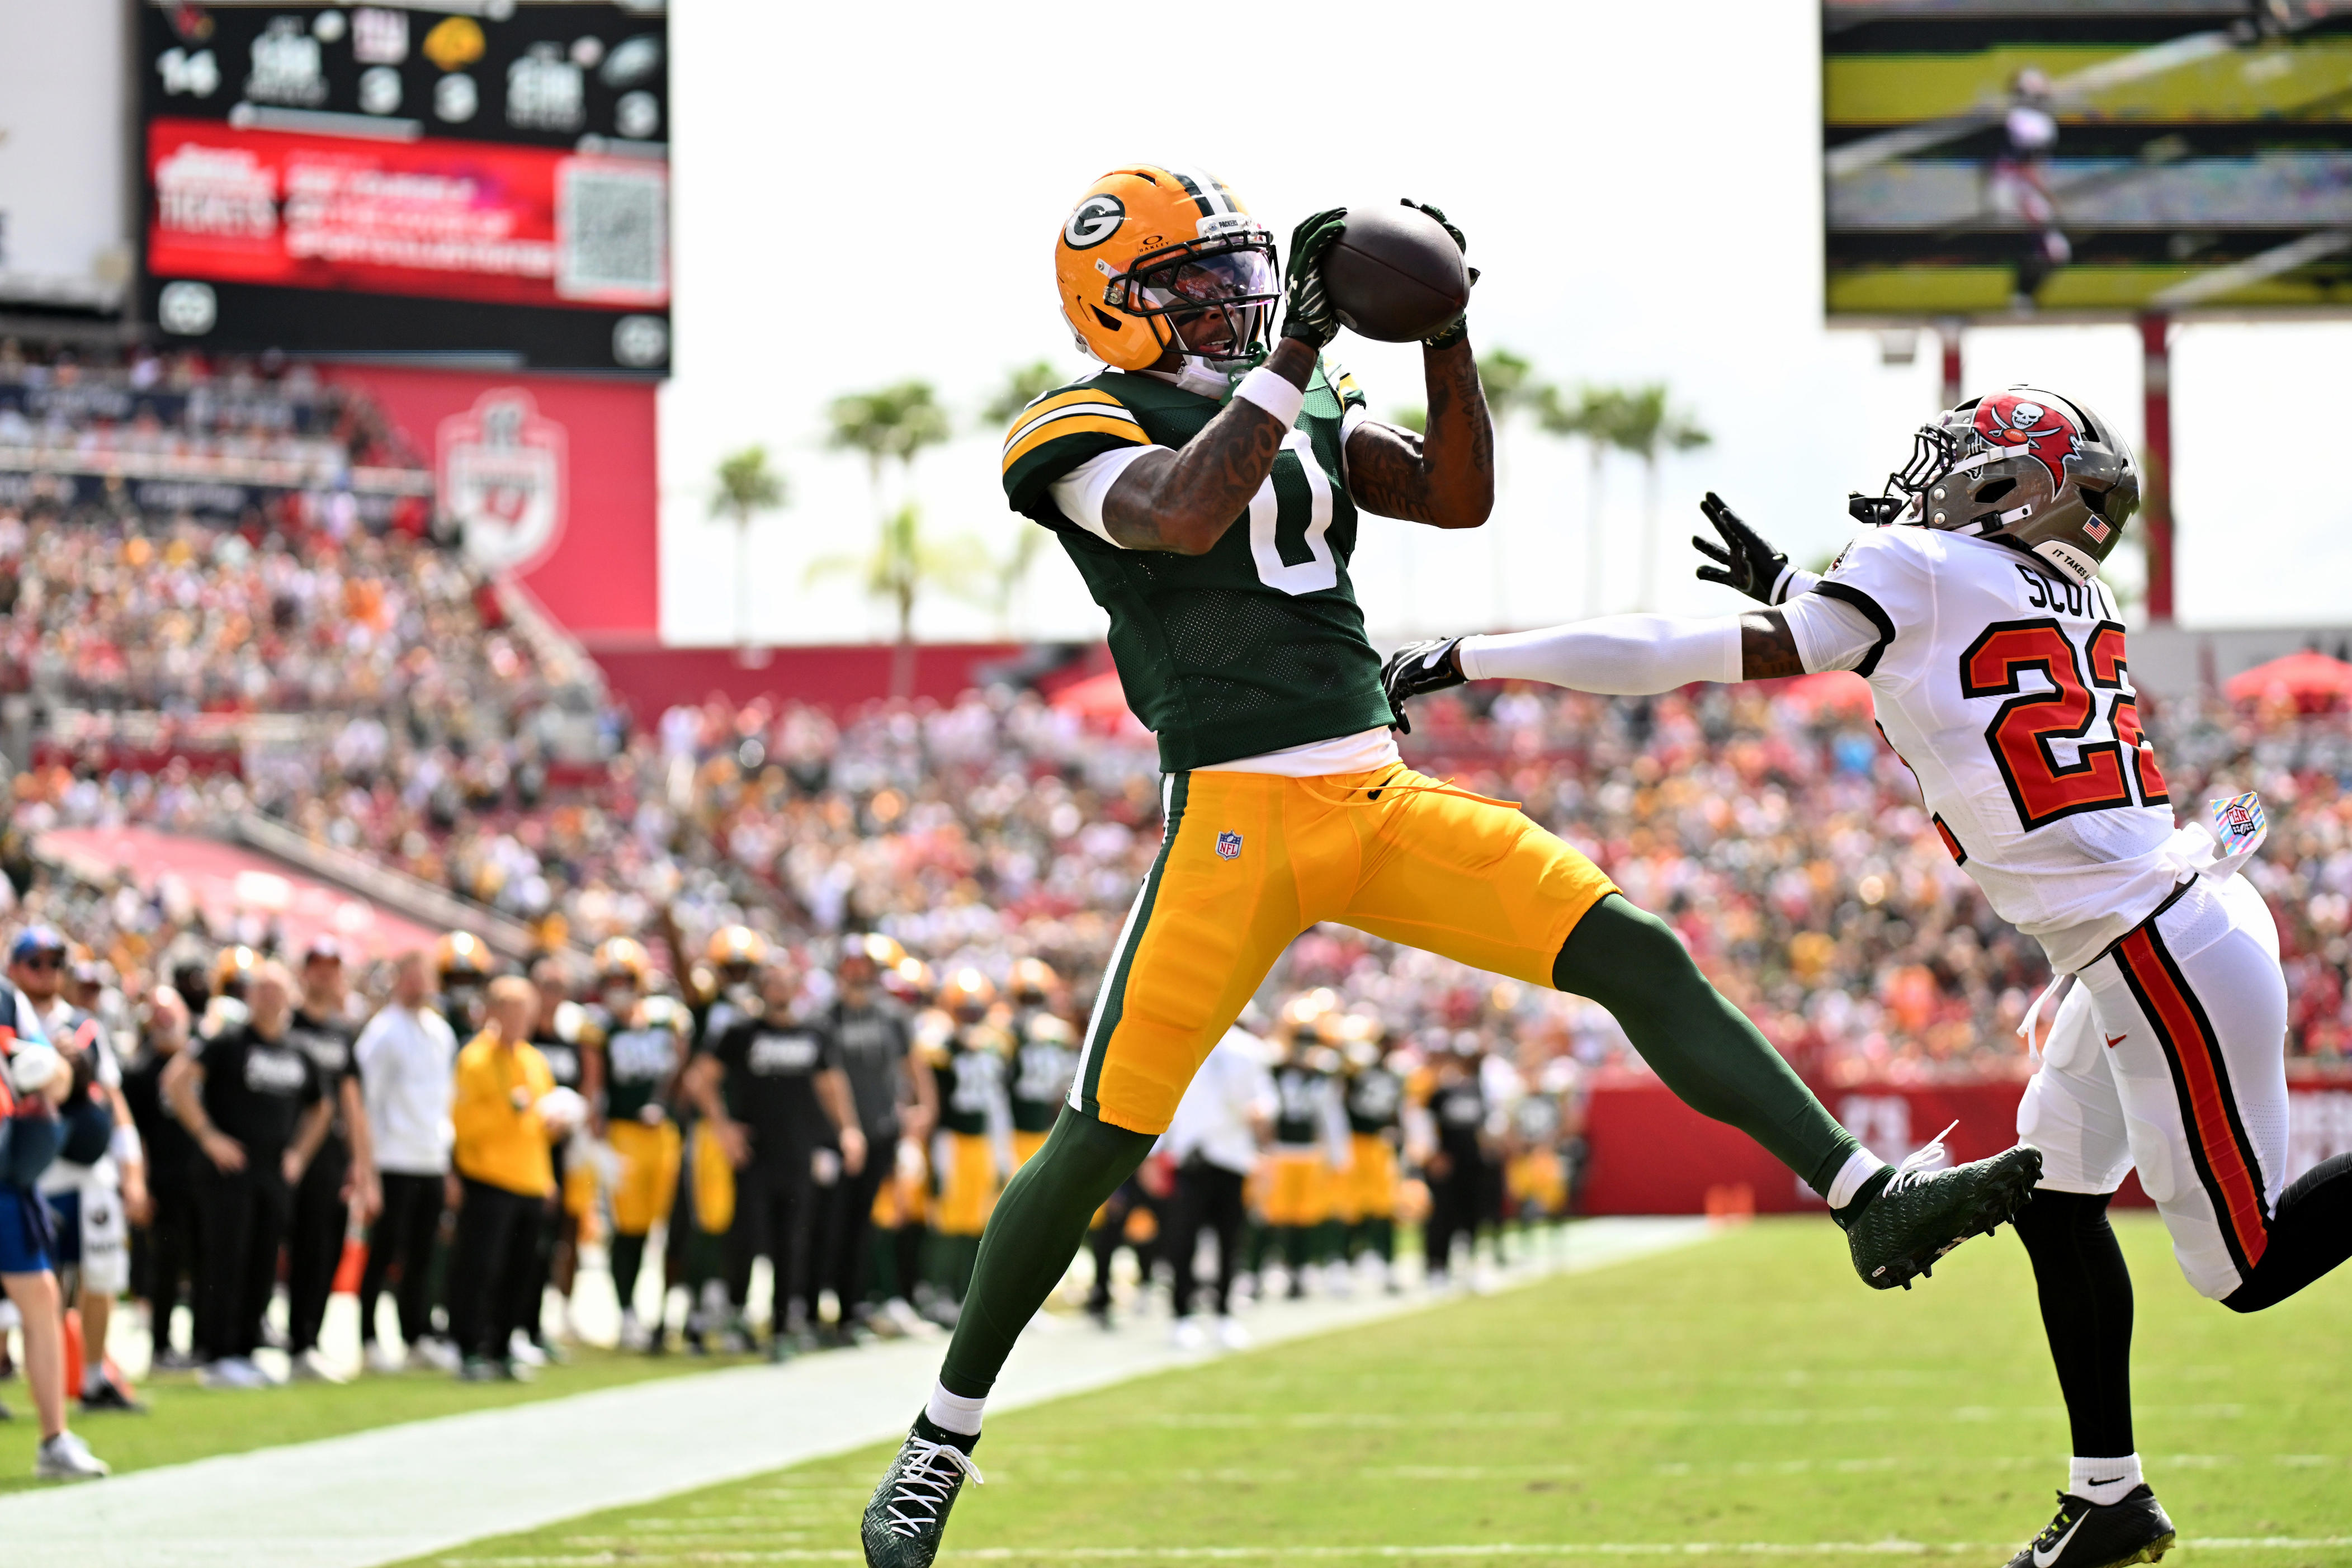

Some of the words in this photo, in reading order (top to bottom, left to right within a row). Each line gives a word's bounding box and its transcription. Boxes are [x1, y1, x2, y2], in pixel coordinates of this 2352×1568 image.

[1065, 197, 1121, 246] G
[1218, 220, 1238, 228] PACKERS
[1139, 241, 1169, 253] OAKLEY
[1249, 427, 1337, 596] 0
[2052, 549, 2065, 558] IT
[2064, 555, 2086, 576] TAKES
[2229, 809, 2249, 823] NFL
[1220, 842, 1236, 855] NFL
